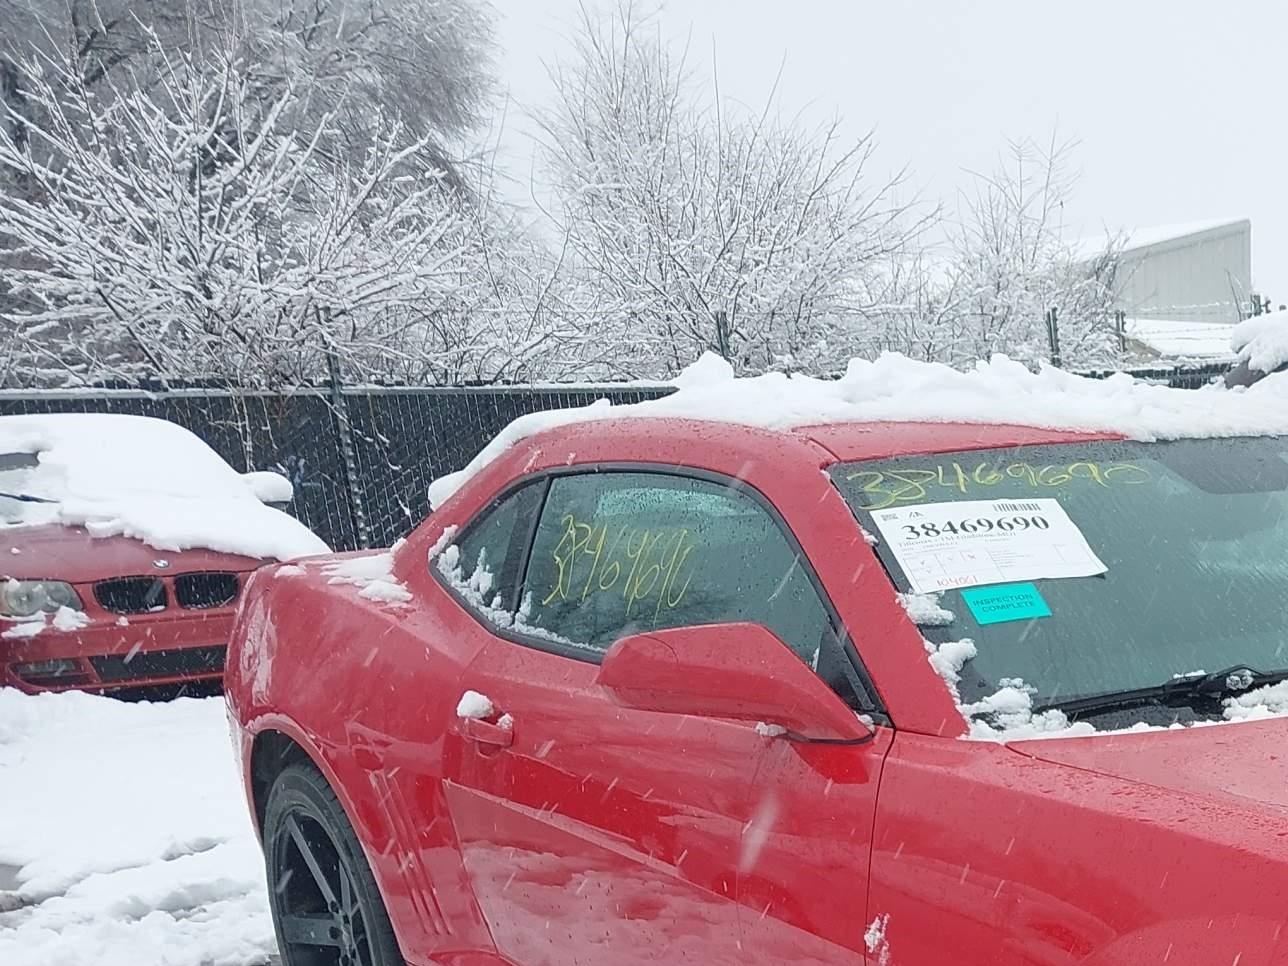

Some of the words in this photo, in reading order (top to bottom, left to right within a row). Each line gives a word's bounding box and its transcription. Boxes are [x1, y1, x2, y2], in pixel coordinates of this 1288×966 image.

[901, 515, 1050, 540] 38469690
[972, 593, 1033, 607] INSPECTION
[982, 601, 1034, 613] COMPLETE
